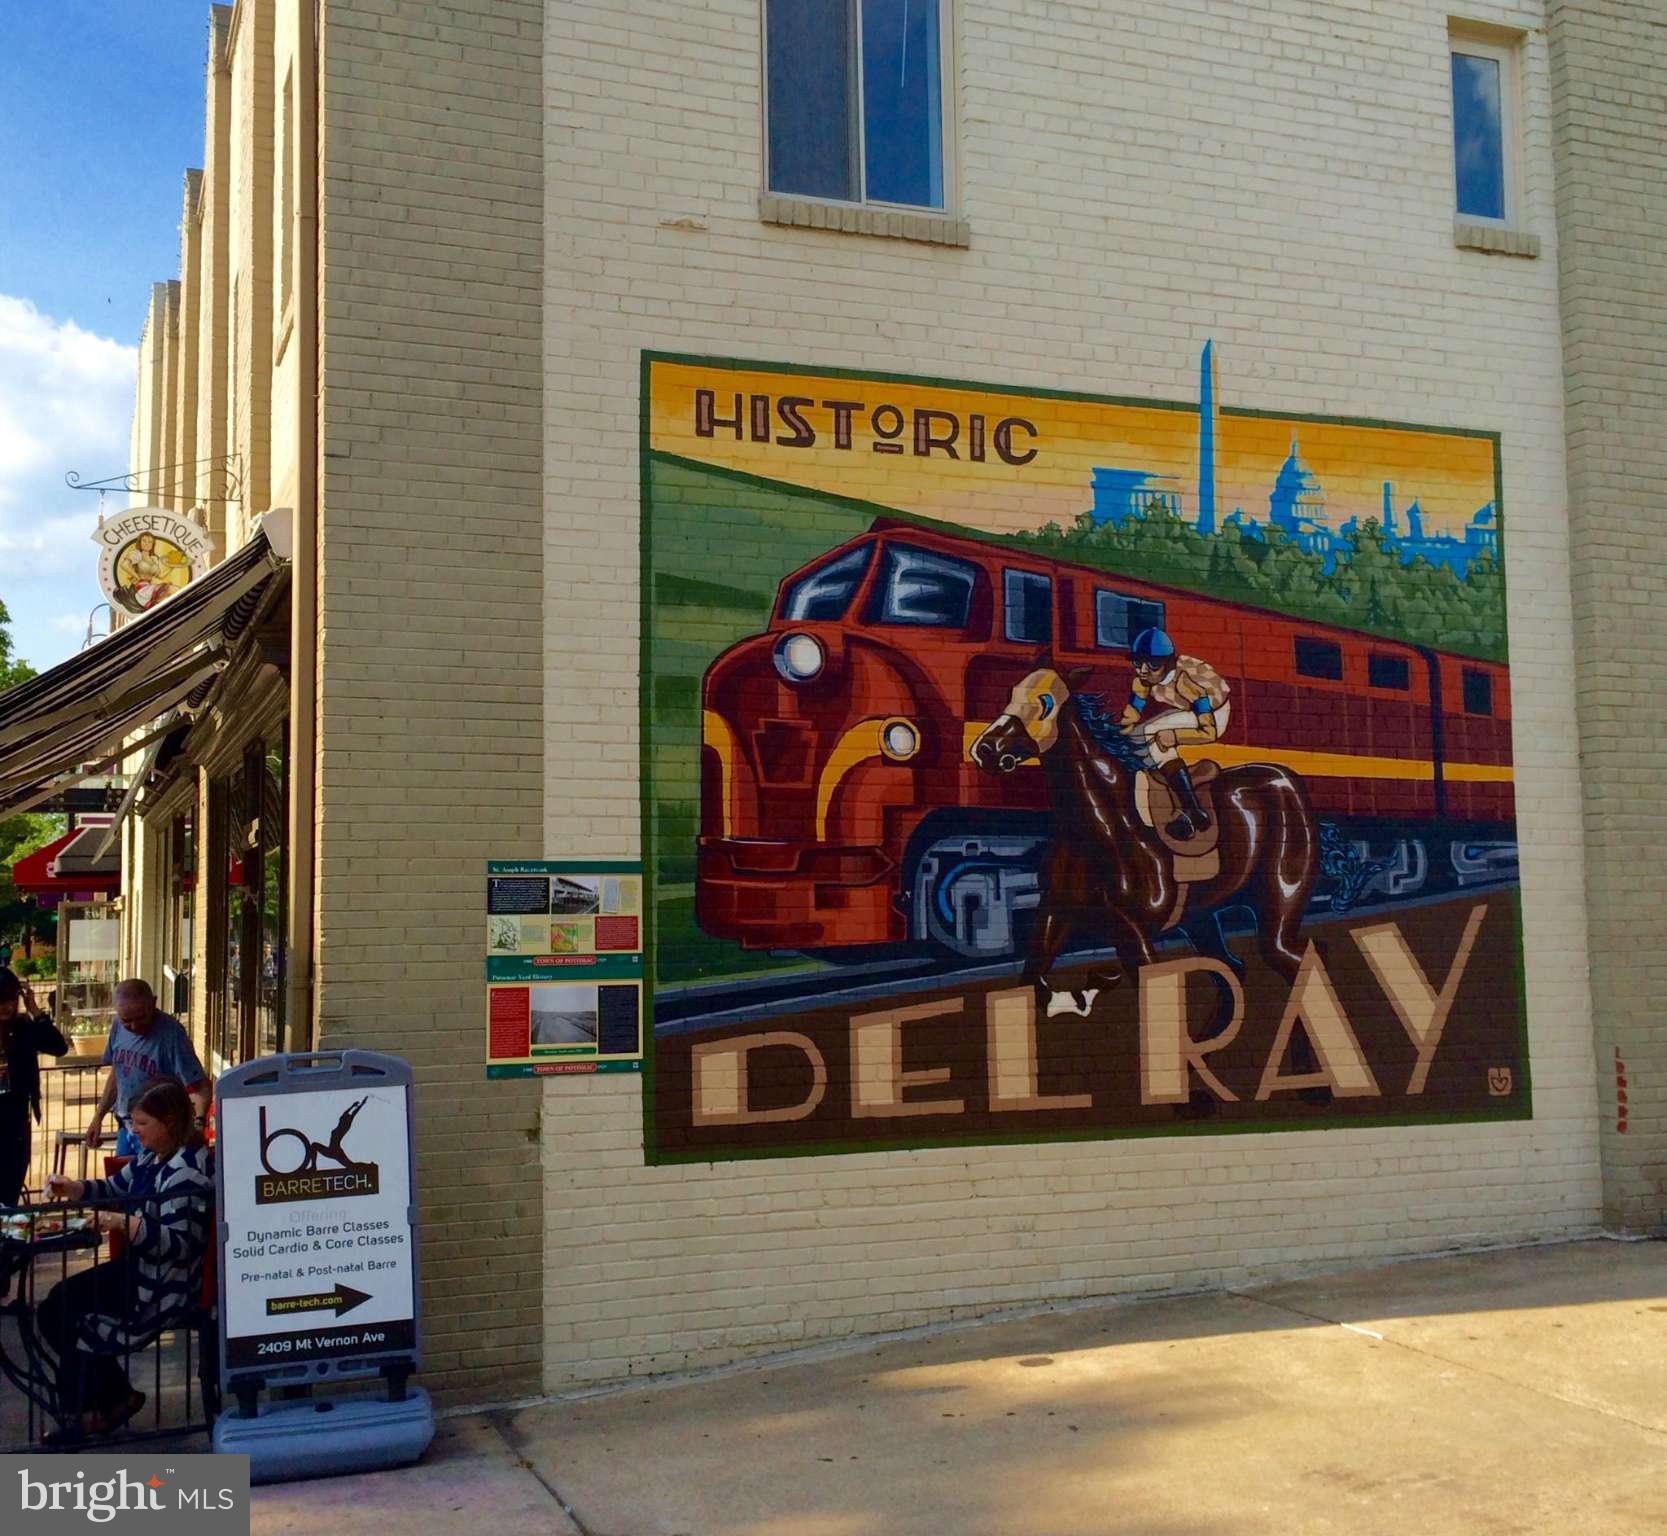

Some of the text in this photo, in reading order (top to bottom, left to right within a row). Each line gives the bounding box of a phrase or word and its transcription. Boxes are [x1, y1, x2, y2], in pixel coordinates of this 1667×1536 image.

[695, 389, 1038, 466] HISTORIC
[103, 515, 203, 554] CHEESETIQUE
[692, 905, 1489, 1127] DEL RAY
[289, 1208, 347, 1223] Offering
[247, 1220, 389, 1243] Dynamic Barre Classes
[233, 1234, 404, 1259] Solid Cardio & Core Classes
[241, 1259, 397, 1283] Pre-natal & Post-natal Barre
[271, 1295, 343, 1311] barre-tech.com
[257, 1331, 385, 1355] 2409 Mt Vernon Ave
